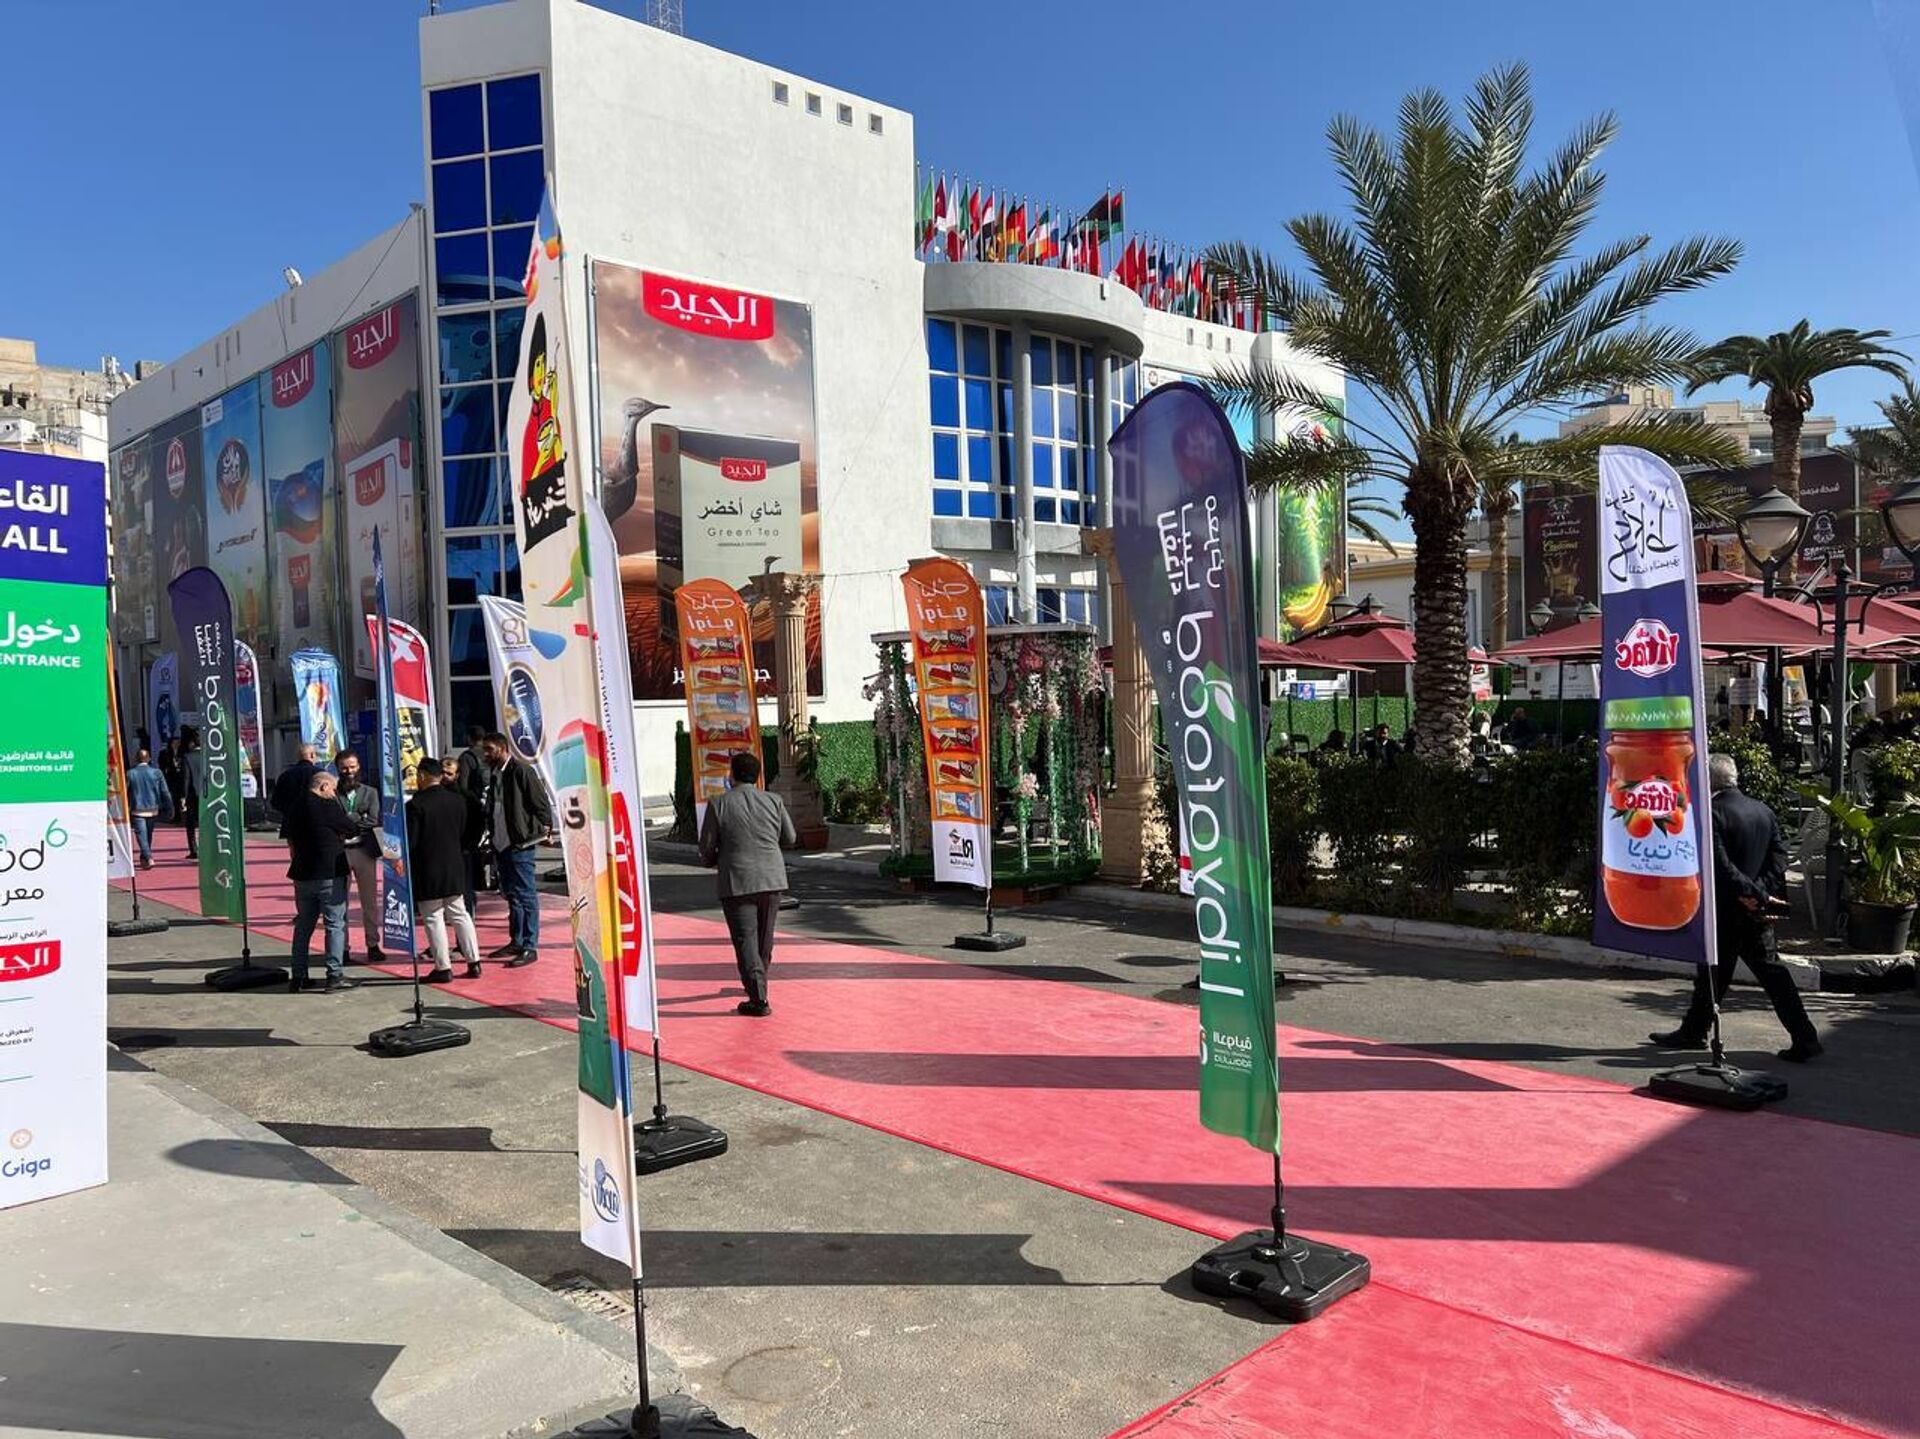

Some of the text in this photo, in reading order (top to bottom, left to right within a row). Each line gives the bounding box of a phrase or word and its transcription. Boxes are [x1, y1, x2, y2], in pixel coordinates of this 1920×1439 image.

[660, 285, 759, 329] الجيد
[352, 306, 393, 359] الجيد
[276, 353, 310, 399] الجيد
[727, 463, 761, 479] الجيد
[697, 496, 783, 523] شاي أخضر
[1, 524, 69, 554] ALL
[707, 526, 780, 538] Green Tea
[0, 611, 81, 649] دخول
[2, 1158, 51, 1178] Giga
